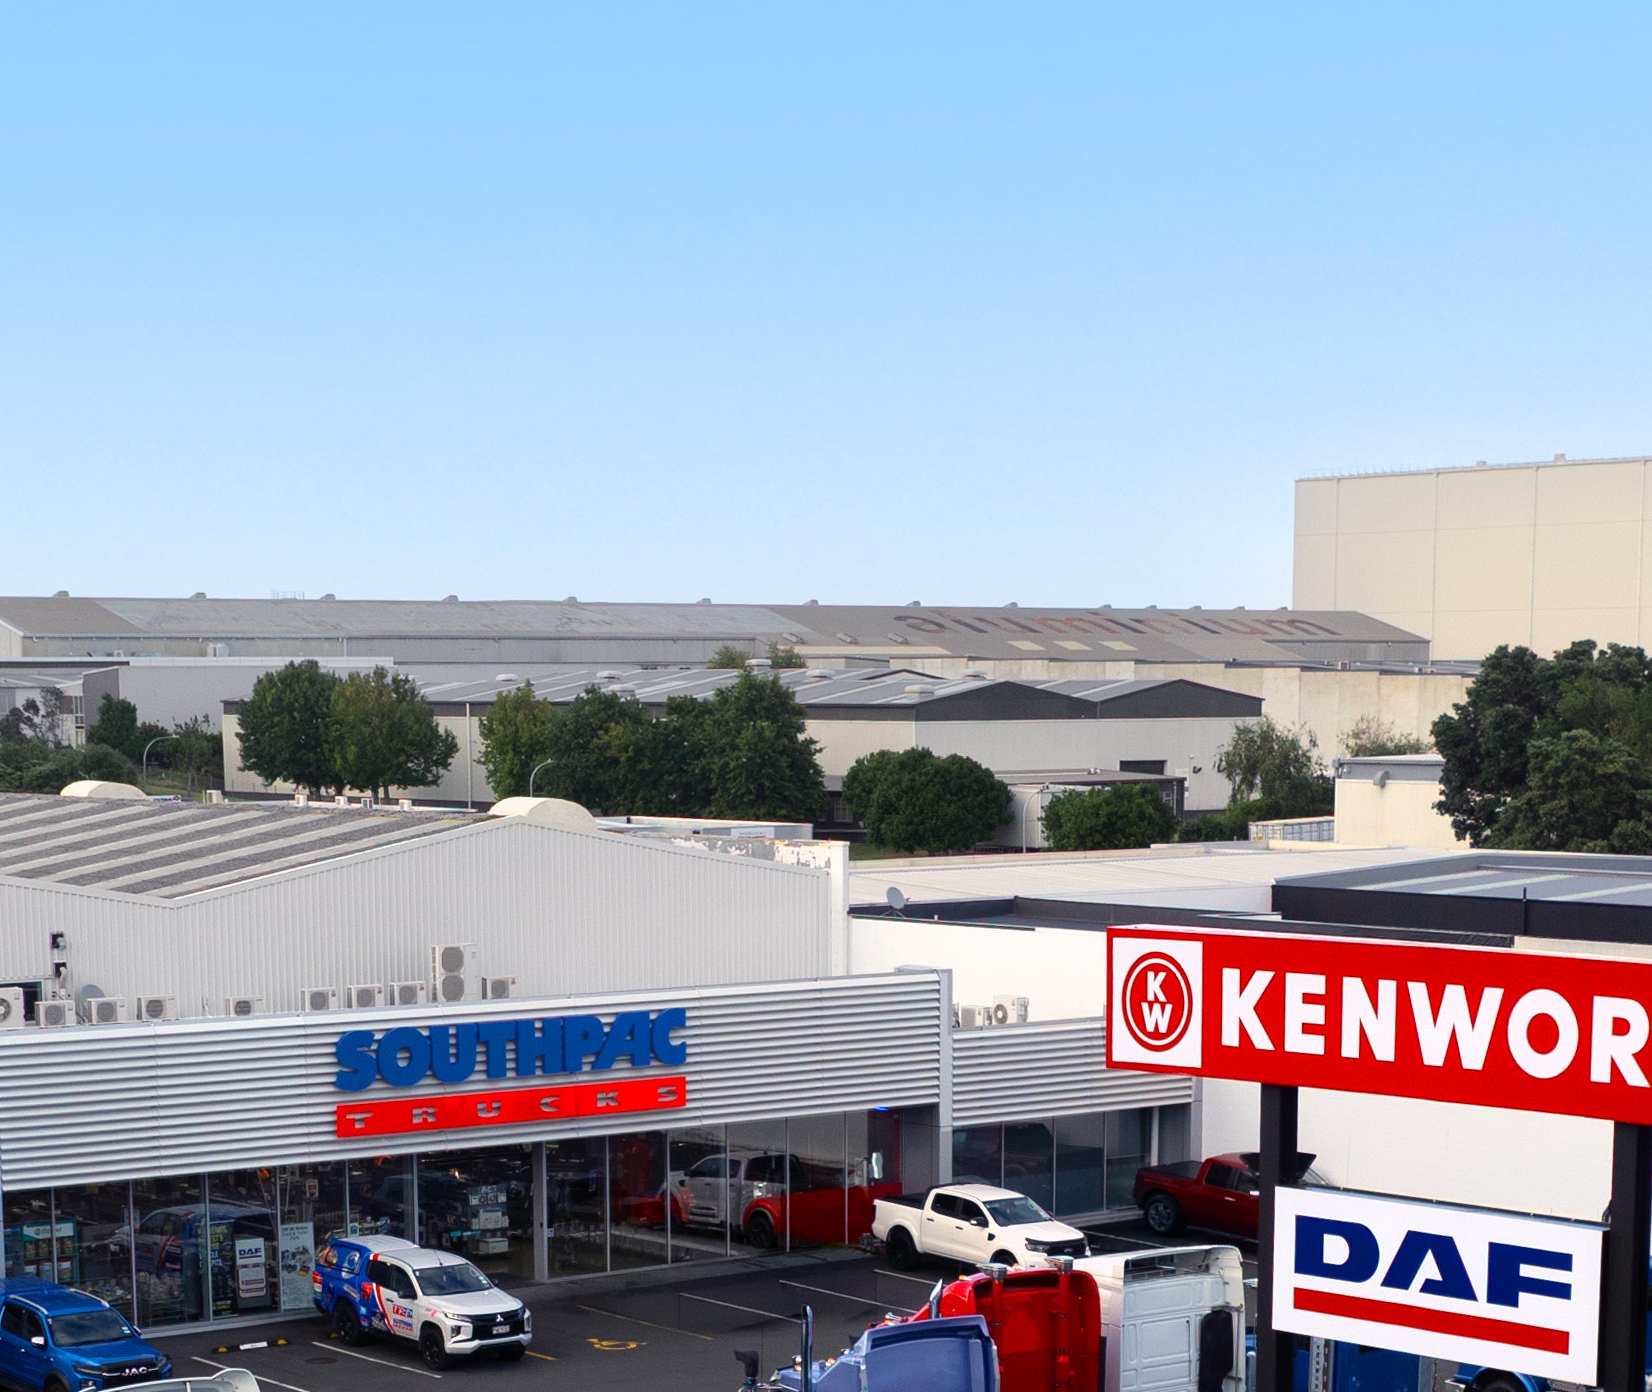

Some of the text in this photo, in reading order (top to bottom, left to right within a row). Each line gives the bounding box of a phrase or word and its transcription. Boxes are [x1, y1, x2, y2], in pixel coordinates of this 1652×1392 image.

[894, 609, 1342, 636] aluminium
[333, 1008, 687, 1092] SOUTHPAC
[346, 1086, 679, 1129] TRUCKS
[238, 1248, 262, 1256] DAF
[1294, 1214, 1573, 1309] DAF
[121, 1366, 148, 1377] JAC
